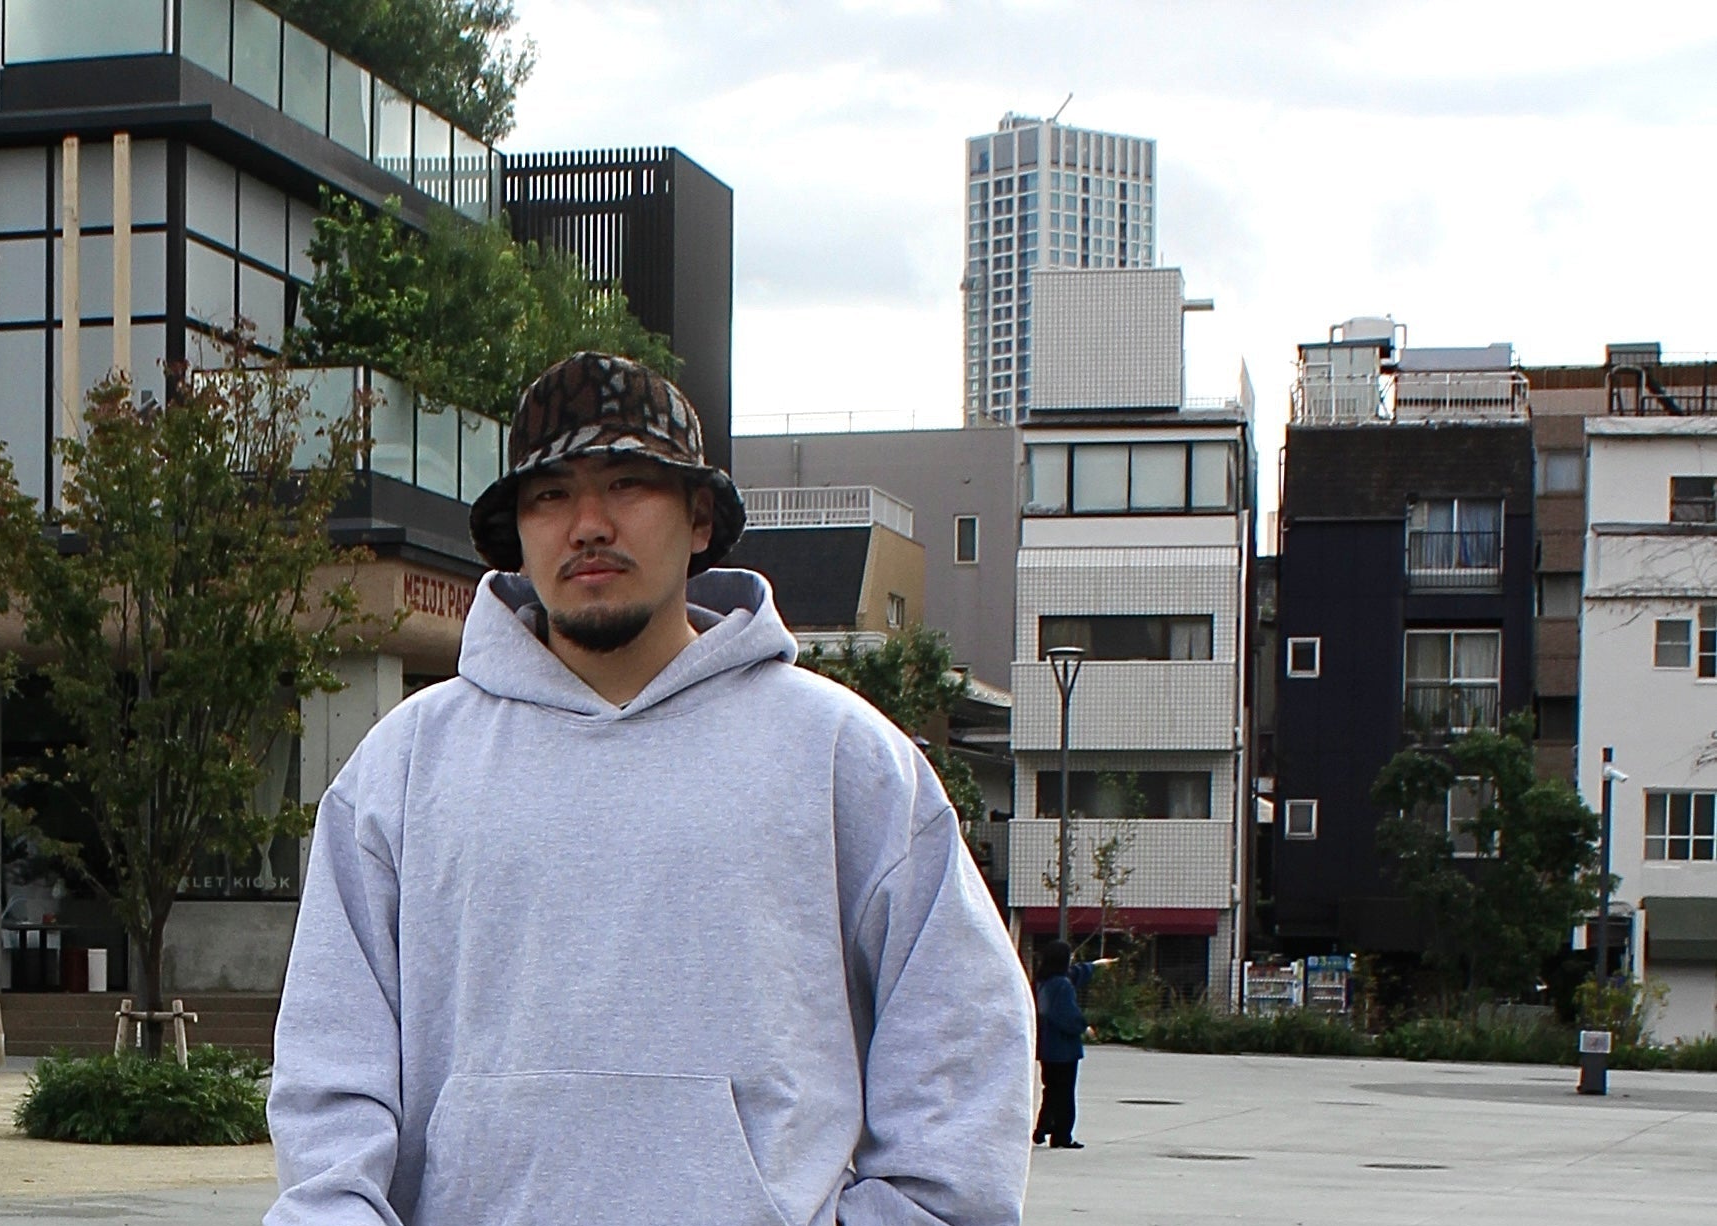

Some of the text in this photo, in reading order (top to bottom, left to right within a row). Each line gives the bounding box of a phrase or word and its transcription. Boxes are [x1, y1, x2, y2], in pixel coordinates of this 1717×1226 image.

[403, 571, 474, 621] MEIJI PAR
[233, 876, 290, 889] KIOSK
